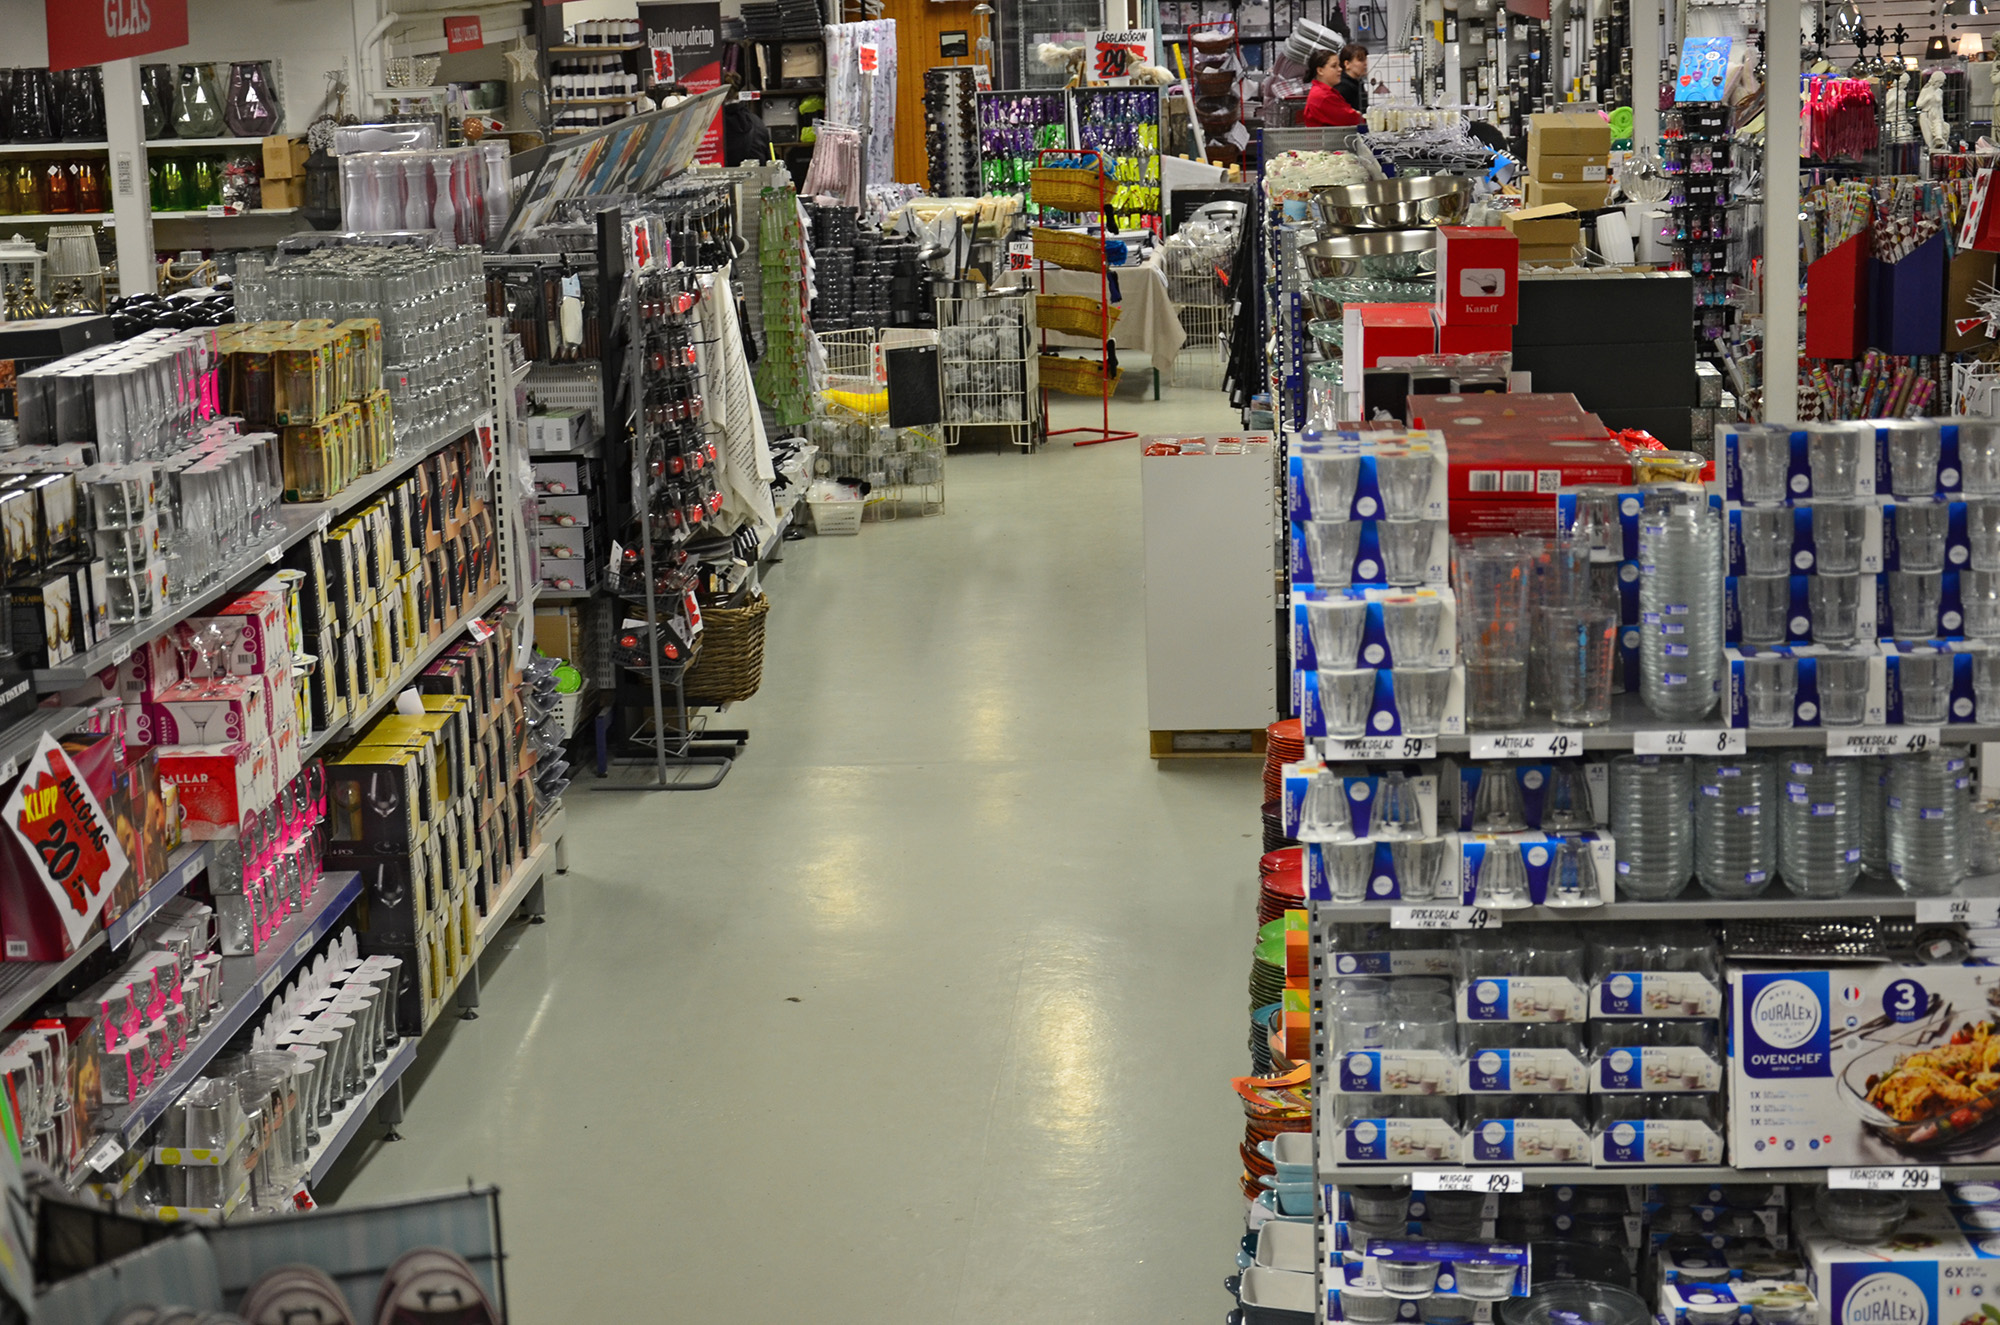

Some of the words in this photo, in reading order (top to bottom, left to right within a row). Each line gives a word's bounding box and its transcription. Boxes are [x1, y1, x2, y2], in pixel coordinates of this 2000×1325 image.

[103, 0, 151, 38] GLAS
[647, 25, 714, 49] Barnfotografering
[1465, 304, 1499, 313] Karaff
[1305, 690, 1313, 727] PICARDIE
[1666, 731, 1687, 744] SKÅL
[24, 785, 58, 823] KLIPP
[60, 775, 109, 852] ALLGLAS
[1950, 900, 1971, 913] SKÅL
[1894, 983, 1916, 1011] 3
[1480, 1006, 1495, 1014] LYS
[1761, 1002, 1812, 1021] DURALEX
[1751, 1053, 1823, 1065] OVENCHEF
[1353, 1078, 1367, 1086] LYS
[1944, 1267, 1963, 1278] 6X
[1863, 1285, 1891, 1298] MADE
[1854, 1299, 1917, 1322] DURALEX
